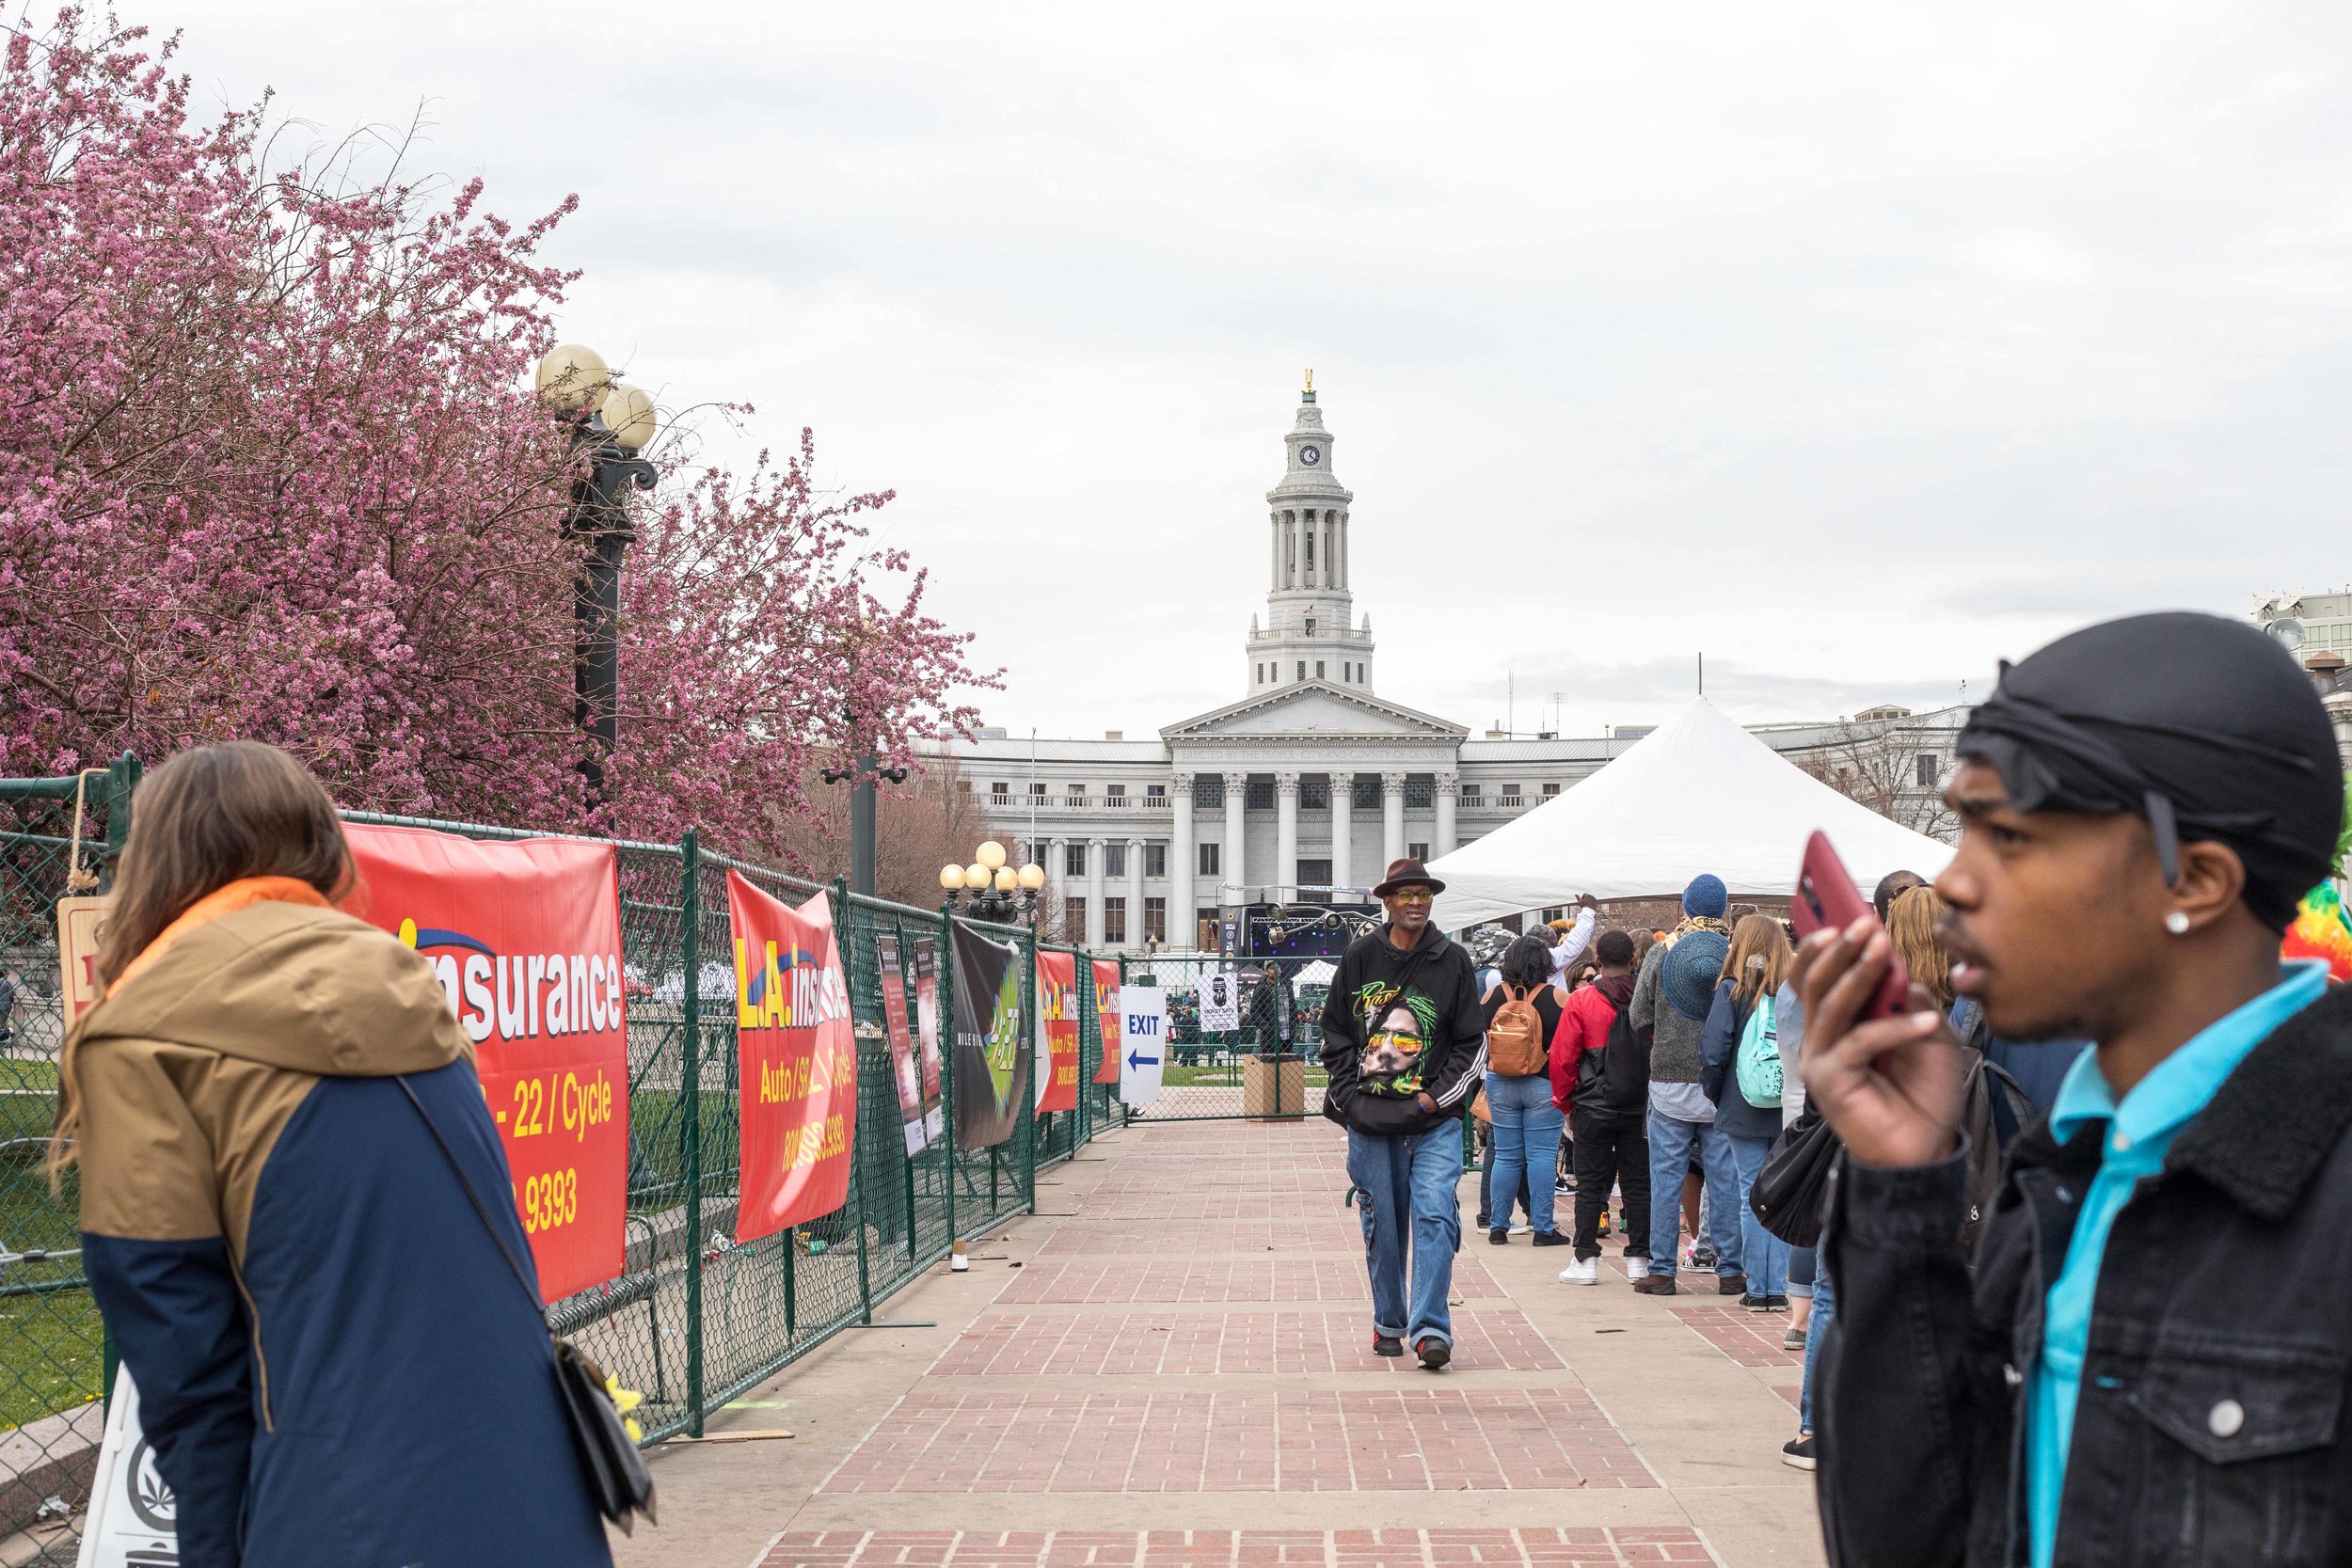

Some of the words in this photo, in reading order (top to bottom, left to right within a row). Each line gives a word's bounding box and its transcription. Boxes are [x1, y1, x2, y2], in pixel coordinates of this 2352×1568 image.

[1182, 751, 1223, 759] ERECTED
[1227, 751, 1238, 759] BY
[1242, 751, 1258, 759] THE
[1263, 751, 1295, 759] PEOPLE
[1301, 751, 1322, 759] CITY
[1326, 751, 1346, 759] AND
[1393, 751, 1406, 759] OF
[1410, 751, 1449, 759] DENVER
[423, 950, 622, 1044] nsurance
[1129, 1014, 1159, 1036] EXIT
[514, 1078, 543, 1138] 22
[563, 1069, 612, 1143] Cycle
[759, 1059, 791, 1104] Auto
[524, 1166, 578, 1234] 9393
